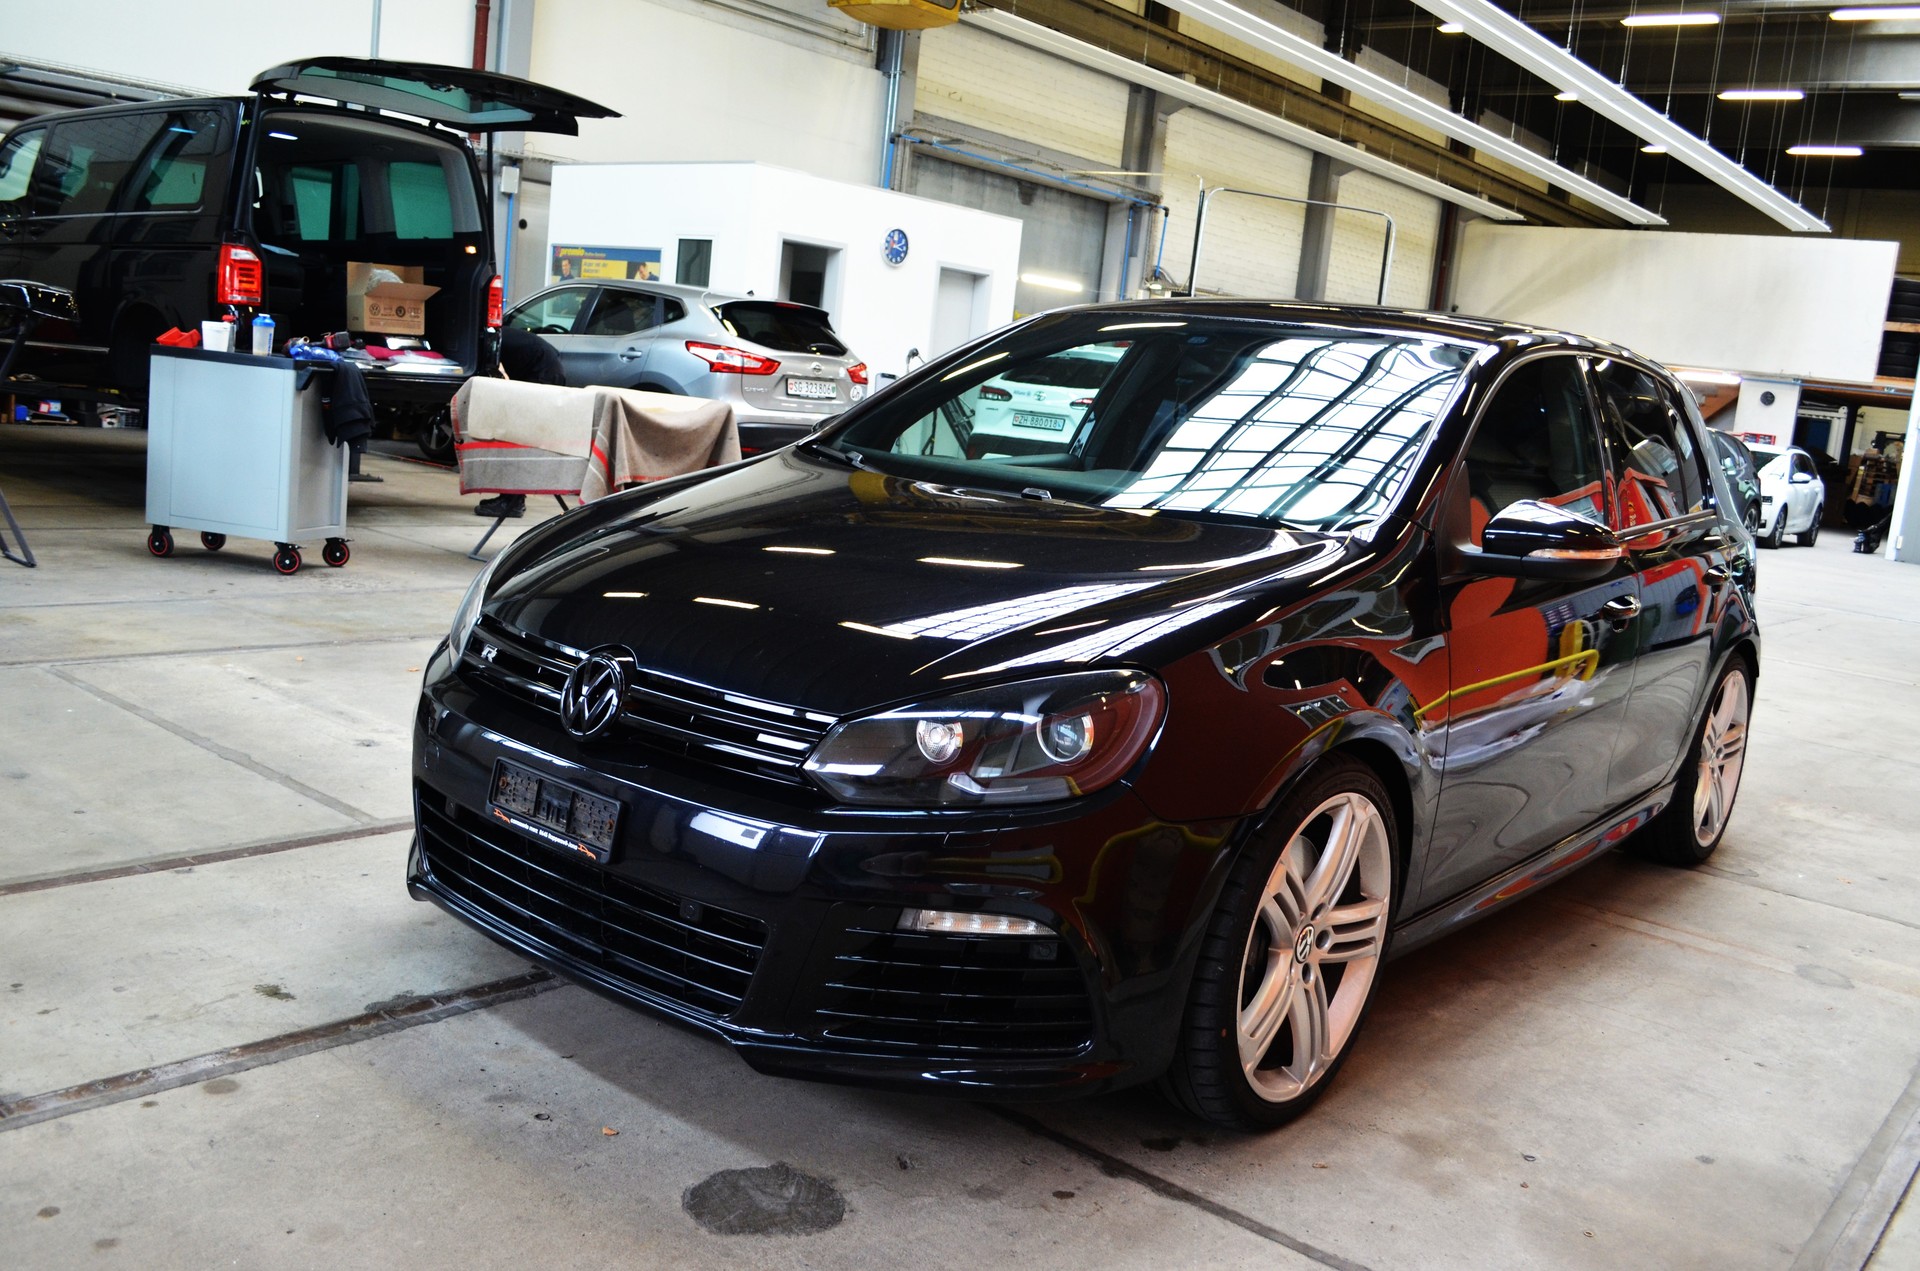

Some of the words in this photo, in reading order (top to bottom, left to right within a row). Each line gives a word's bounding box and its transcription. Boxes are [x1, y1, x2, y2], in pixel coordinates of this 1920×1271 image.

[559, 247, 585, 258] premio
[794, 381, 802, 392] SG
[805, 382, 831, 395] 323806
[1019, 415, 1028, 425] ZH
[1030, 416, 1058, 428] 880018
